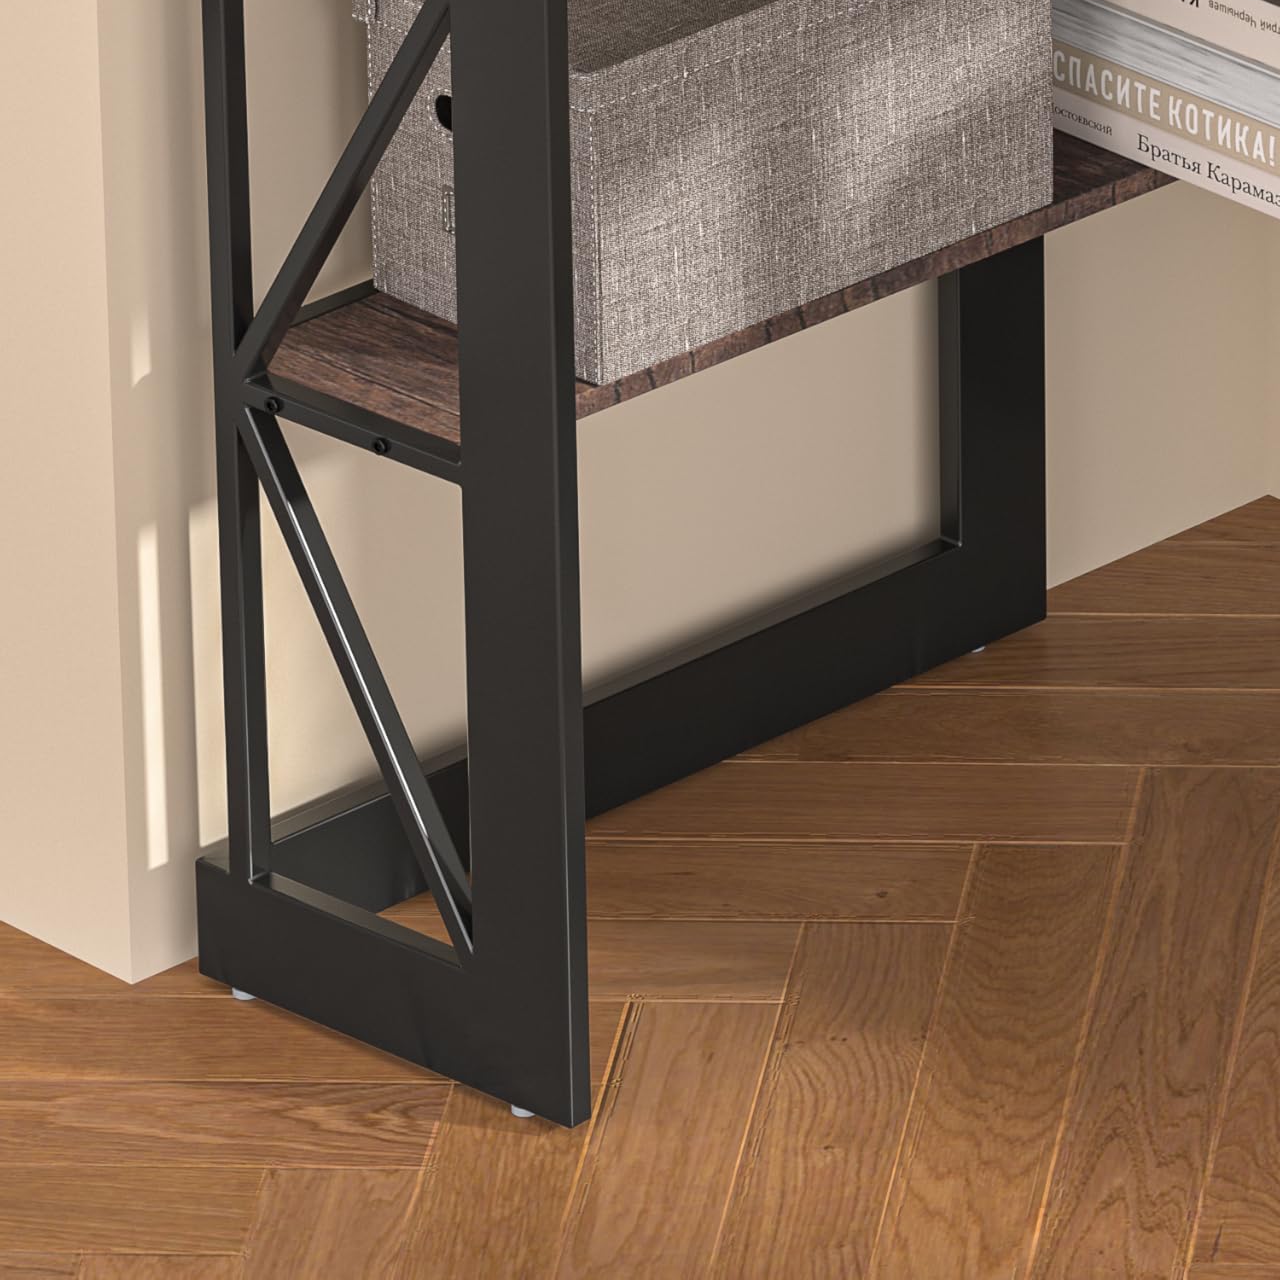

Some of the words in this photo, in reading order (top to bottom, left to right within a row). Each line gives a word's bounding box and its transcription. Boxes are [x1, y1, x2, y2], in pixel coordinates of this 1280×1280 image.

[1208, 0, 1257, 28] Чернышев
[1052, 50, 1161, 121] СПАСИТЕ
[1168, 95, 1277, 167] КОТИКА!
[1136, 132, 1203, 175] Братья
